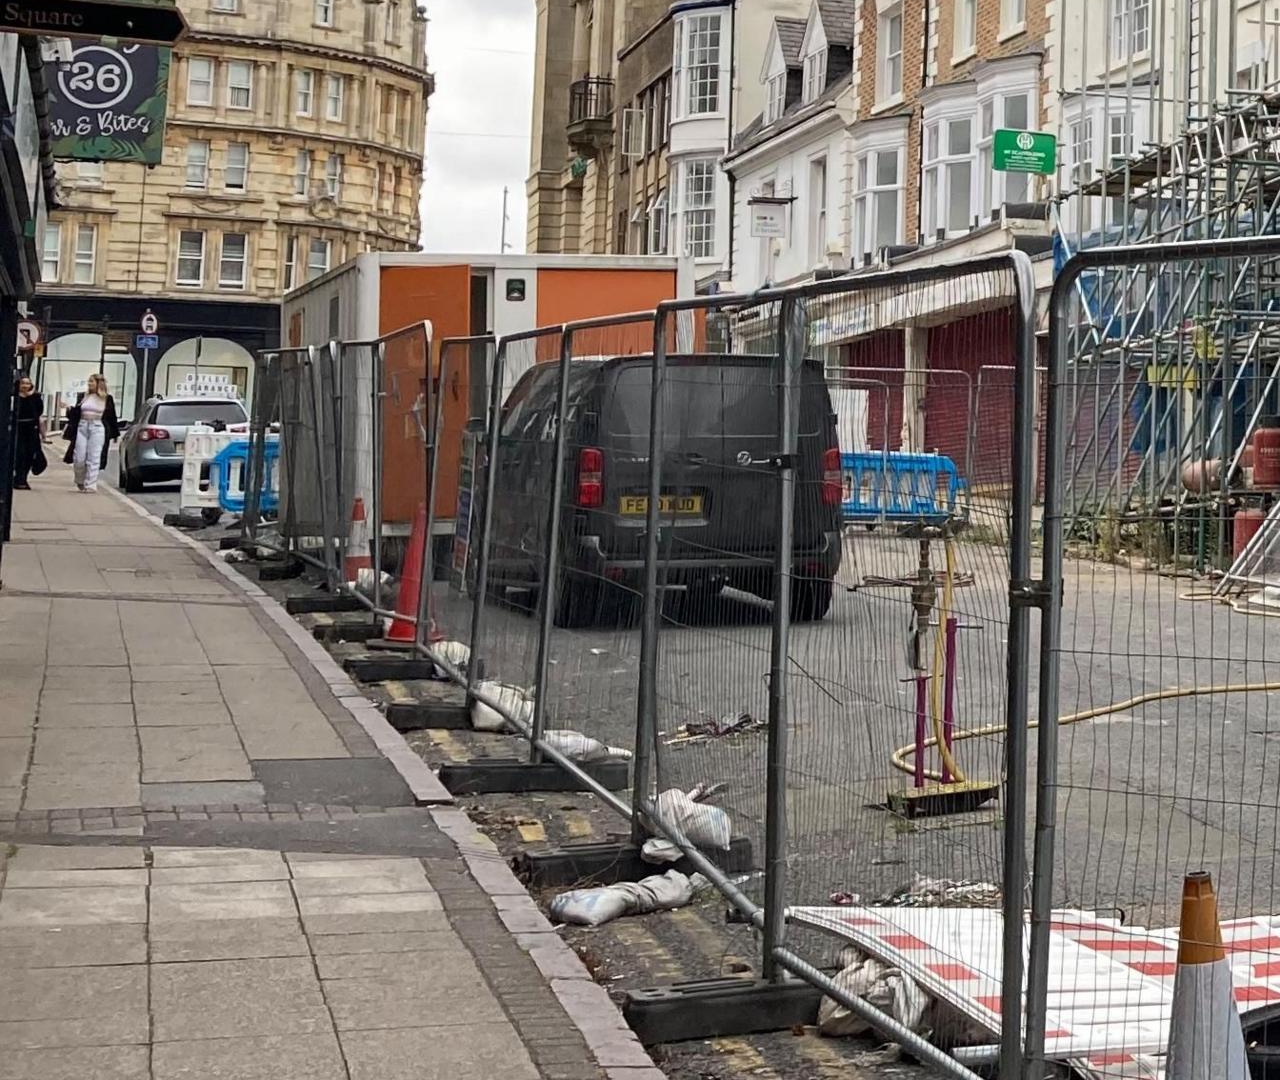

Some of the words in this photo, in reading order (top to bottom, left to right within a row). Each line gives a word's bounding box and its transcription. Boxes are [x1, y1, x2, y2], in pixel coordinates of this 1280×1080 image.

[4, 3, 85, 27] Square
[69, 61, 121, 93] 26
[97, 110, 151, 136] Bites
